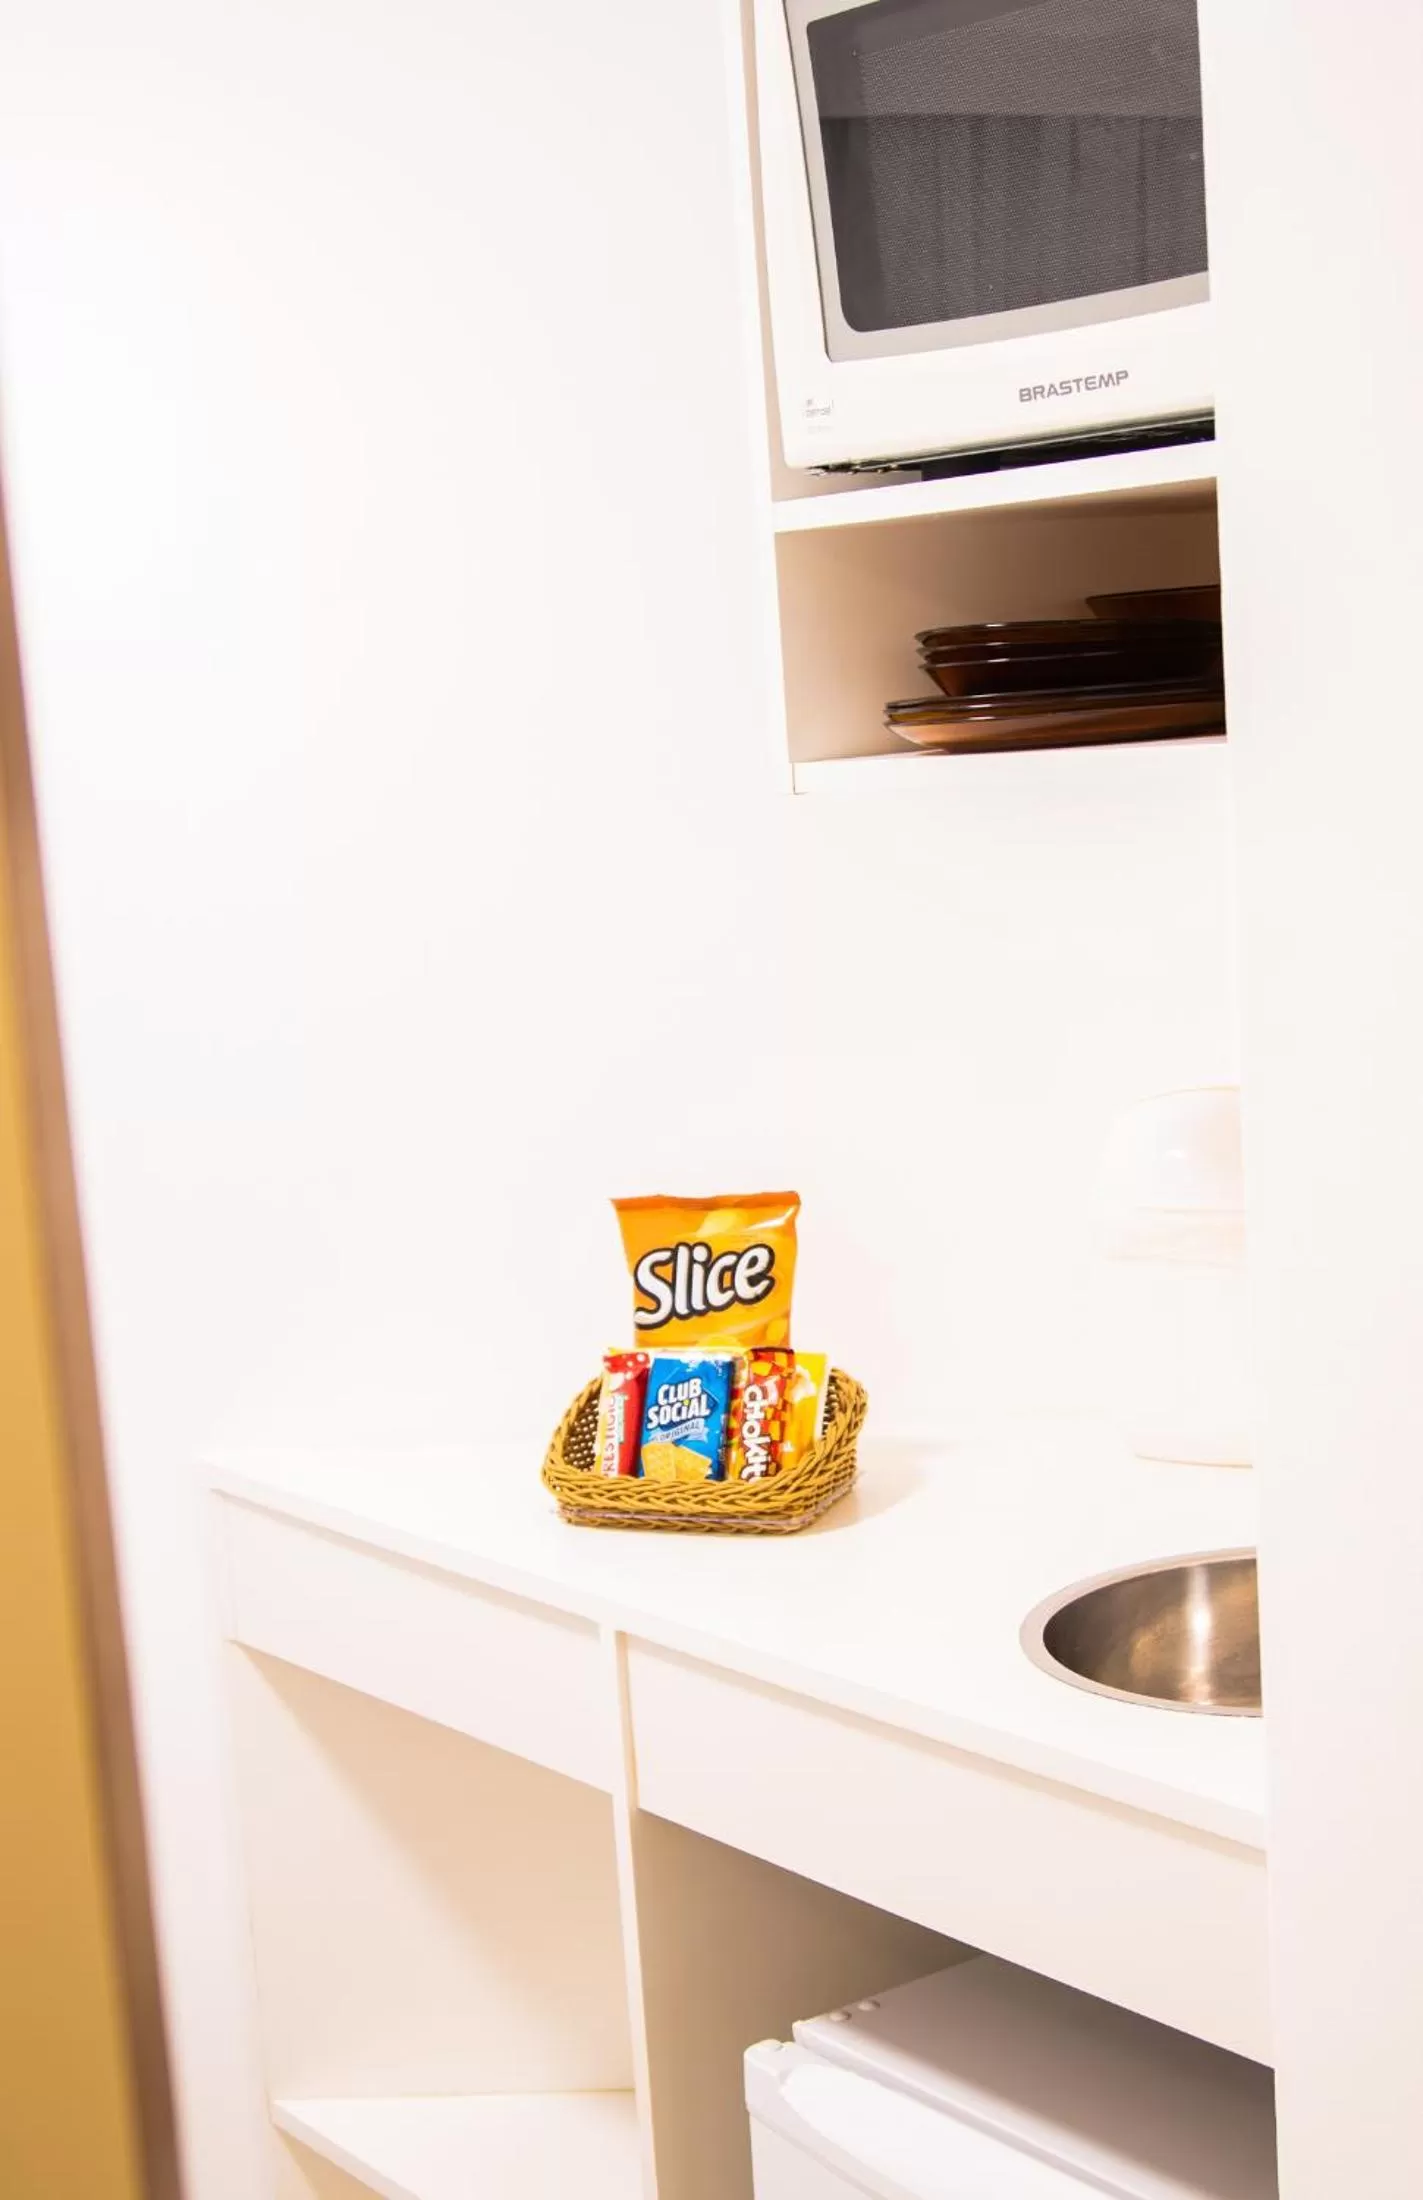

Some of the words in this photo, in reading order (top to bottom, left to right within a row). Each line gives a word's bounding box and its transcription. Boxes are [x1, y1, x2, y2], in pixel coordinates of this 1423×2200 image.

[1019, 370, 1129, 402] BRASTEMP
[634, 1241, 775, 1329] Slice
[657, 1377, 702, 1405] CLUB
